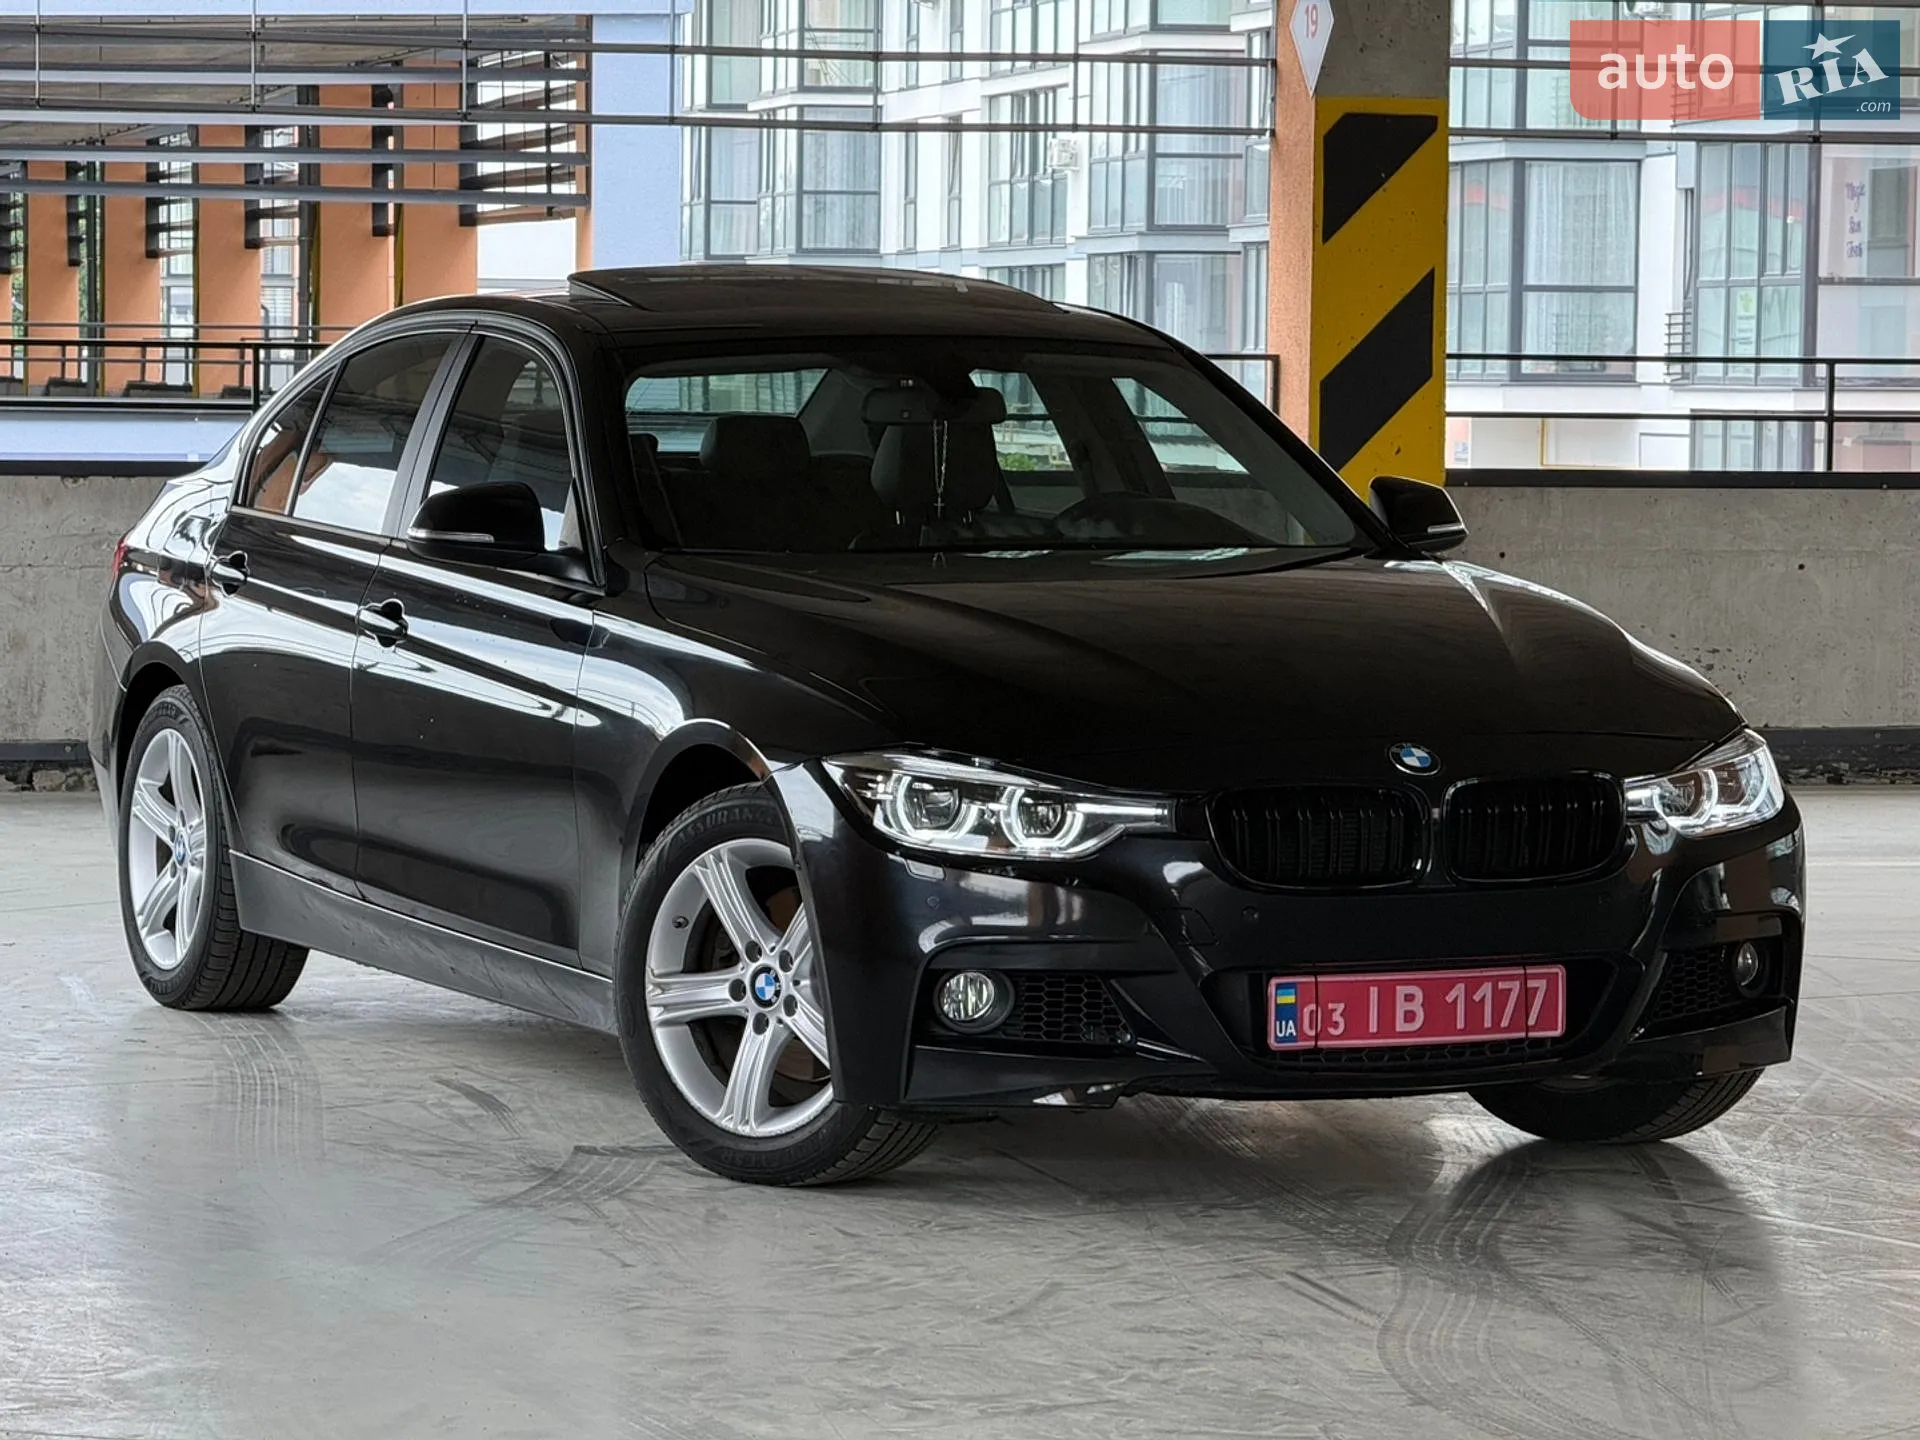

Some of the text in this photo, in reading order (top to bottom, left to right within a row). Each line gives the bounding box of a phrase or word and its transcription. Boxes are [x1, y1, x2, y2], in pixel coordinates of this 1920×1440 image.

[1305, 4, 1318, 38] 19
[1302, 1003, 1346, 1037] 03
[1445, 979, 1548, 1030] 1177
[1276, 1020, 1297, 1038] UA
